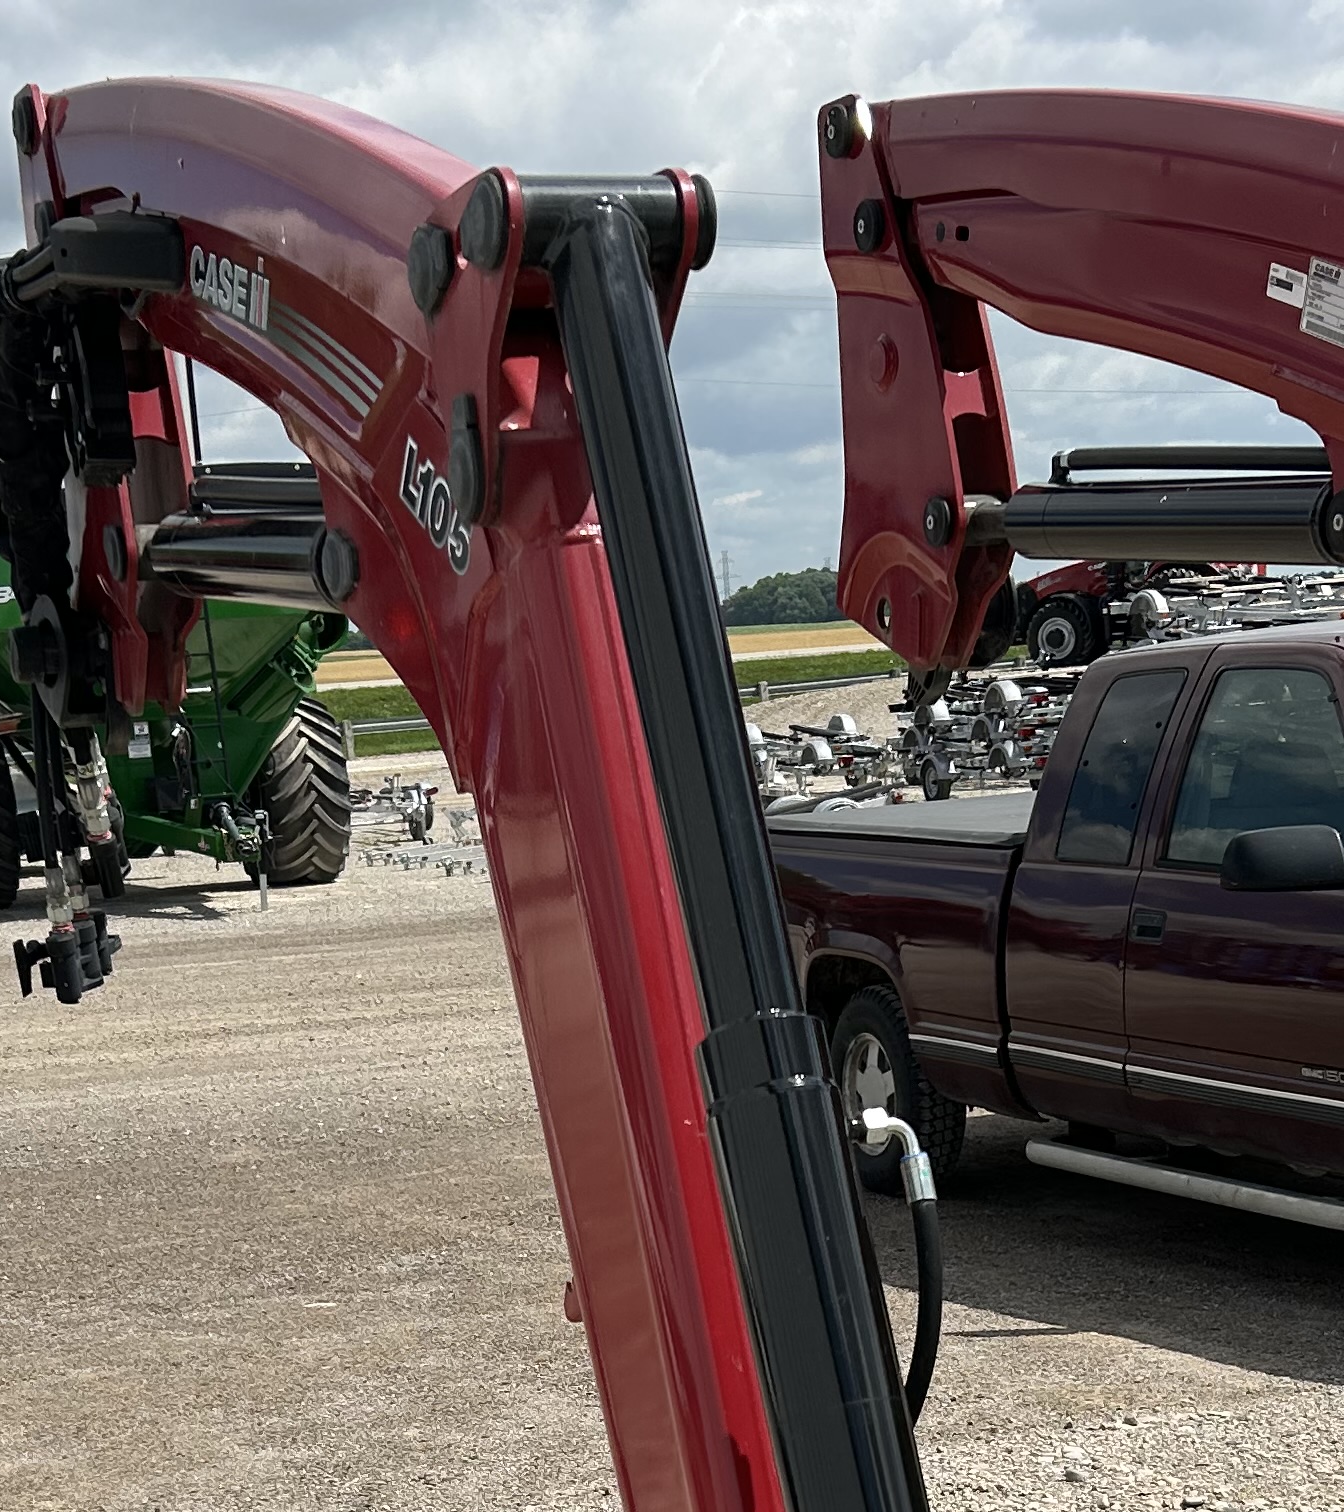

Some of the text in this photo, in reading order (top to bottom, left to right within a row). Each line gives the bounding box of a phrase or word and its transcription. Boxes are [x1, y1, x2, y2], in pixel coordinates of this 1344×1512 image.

[189, 244, 249, 321] CASE
[1314, 262, 1335, 277] CASE
[399, 433, 473, 576] L105
